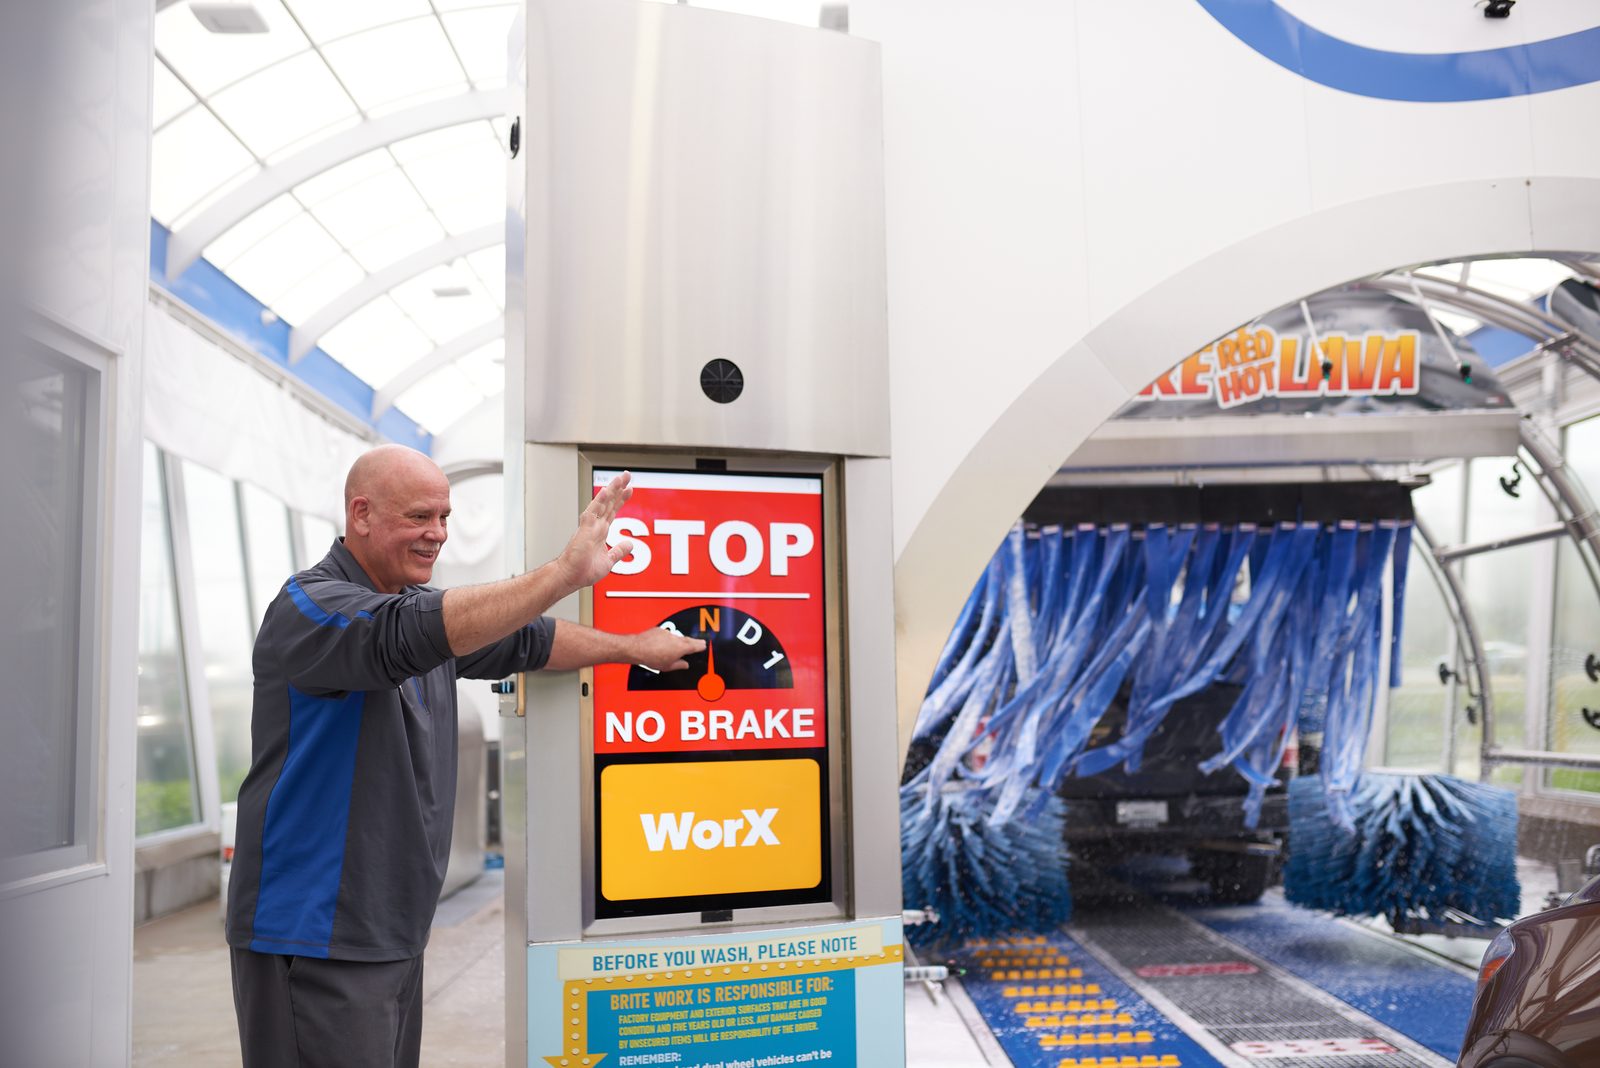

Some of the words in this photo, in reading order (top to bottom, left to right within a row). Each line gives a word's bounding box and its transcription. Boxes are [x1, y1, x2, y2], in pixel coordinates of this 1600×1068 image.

[1217, 327, 1274, 369] RED
[1278, 334, 1416, 392] LAVA
[1218, 361, 1275, 403] HOT
[605, 517, 815, 577] STOP
[699, 608, 720, 633] N
[736, 617, 763, 646] D
[605, 710, 666, 743] NO
[680, 708, 815, 741] BRAKE
[639, 807, 781, 852] WorX
[593, 953, 658, 971] BEFORE
[664, 950, 695, 967] YOU
[701, 946, 752, 964] WASH,
[758, 940, 816, 960] PLEASE
[821, 936, 857, 954] NOTE
[610, 993, 650, 1011] BRITE
[654, 989, 694, 1007] WORX
[697, 988, 711, 1004] IS
[715, 979, 803, 1002] RESPONSIBLE
[806, 976, 834, 993] FOR:
[618, 1013, 649, 1024] FACTORY
[650, 1010, 689, 1022] EQUIPMENT
[690, 1009, 704, 1019] AND
[705, 1006, 737, 1017] EXTERIOR
[737, 1002, 771, 1014] SURFACES
[771, 1001, 788, 1011] THAT
[789, 999, 801, 1009] ARE
[802, 999, 809, 1007] IN
[809, 996, 827, 1006] GOOD
[618, 1025, 655, 1036] CONDITION
[656, 1023, 671, 1033] AND
[672, 1022, 687, 1032] FIVE
[688, 1020, 710, 1030] YEARS
[711, 1019, 725, 1028] OLD
[725, 1017, 736, 1027] OR
[737, 1016, 755, 1026] LESS.
[756, 1014, 770, 1024] ANY
[770, 1011, 797, 1022] DAMAGE
[797, 1008, 822, 1019] CAUSED
[618, 1040, 628, 1049] BY
[629, 1037, 670, 1048] UNSECURED
[671, 1035, 692, 1045] ITEMS
[692, 1033, 709, 1043] WILL
[709, 1032, 720, 1041] BE
[771, 1026, 781, 1035] OF
[782, 1024, 794, 1034] THE
[619, 1052, 682, 1066] REMEMBER:
[725, 1057, 755, 1068] wheel
[756, 1054, 795, 1067] vehicles
[796, 1050, 819, 1062] can't
[819, 1049, 832, 1059] be
